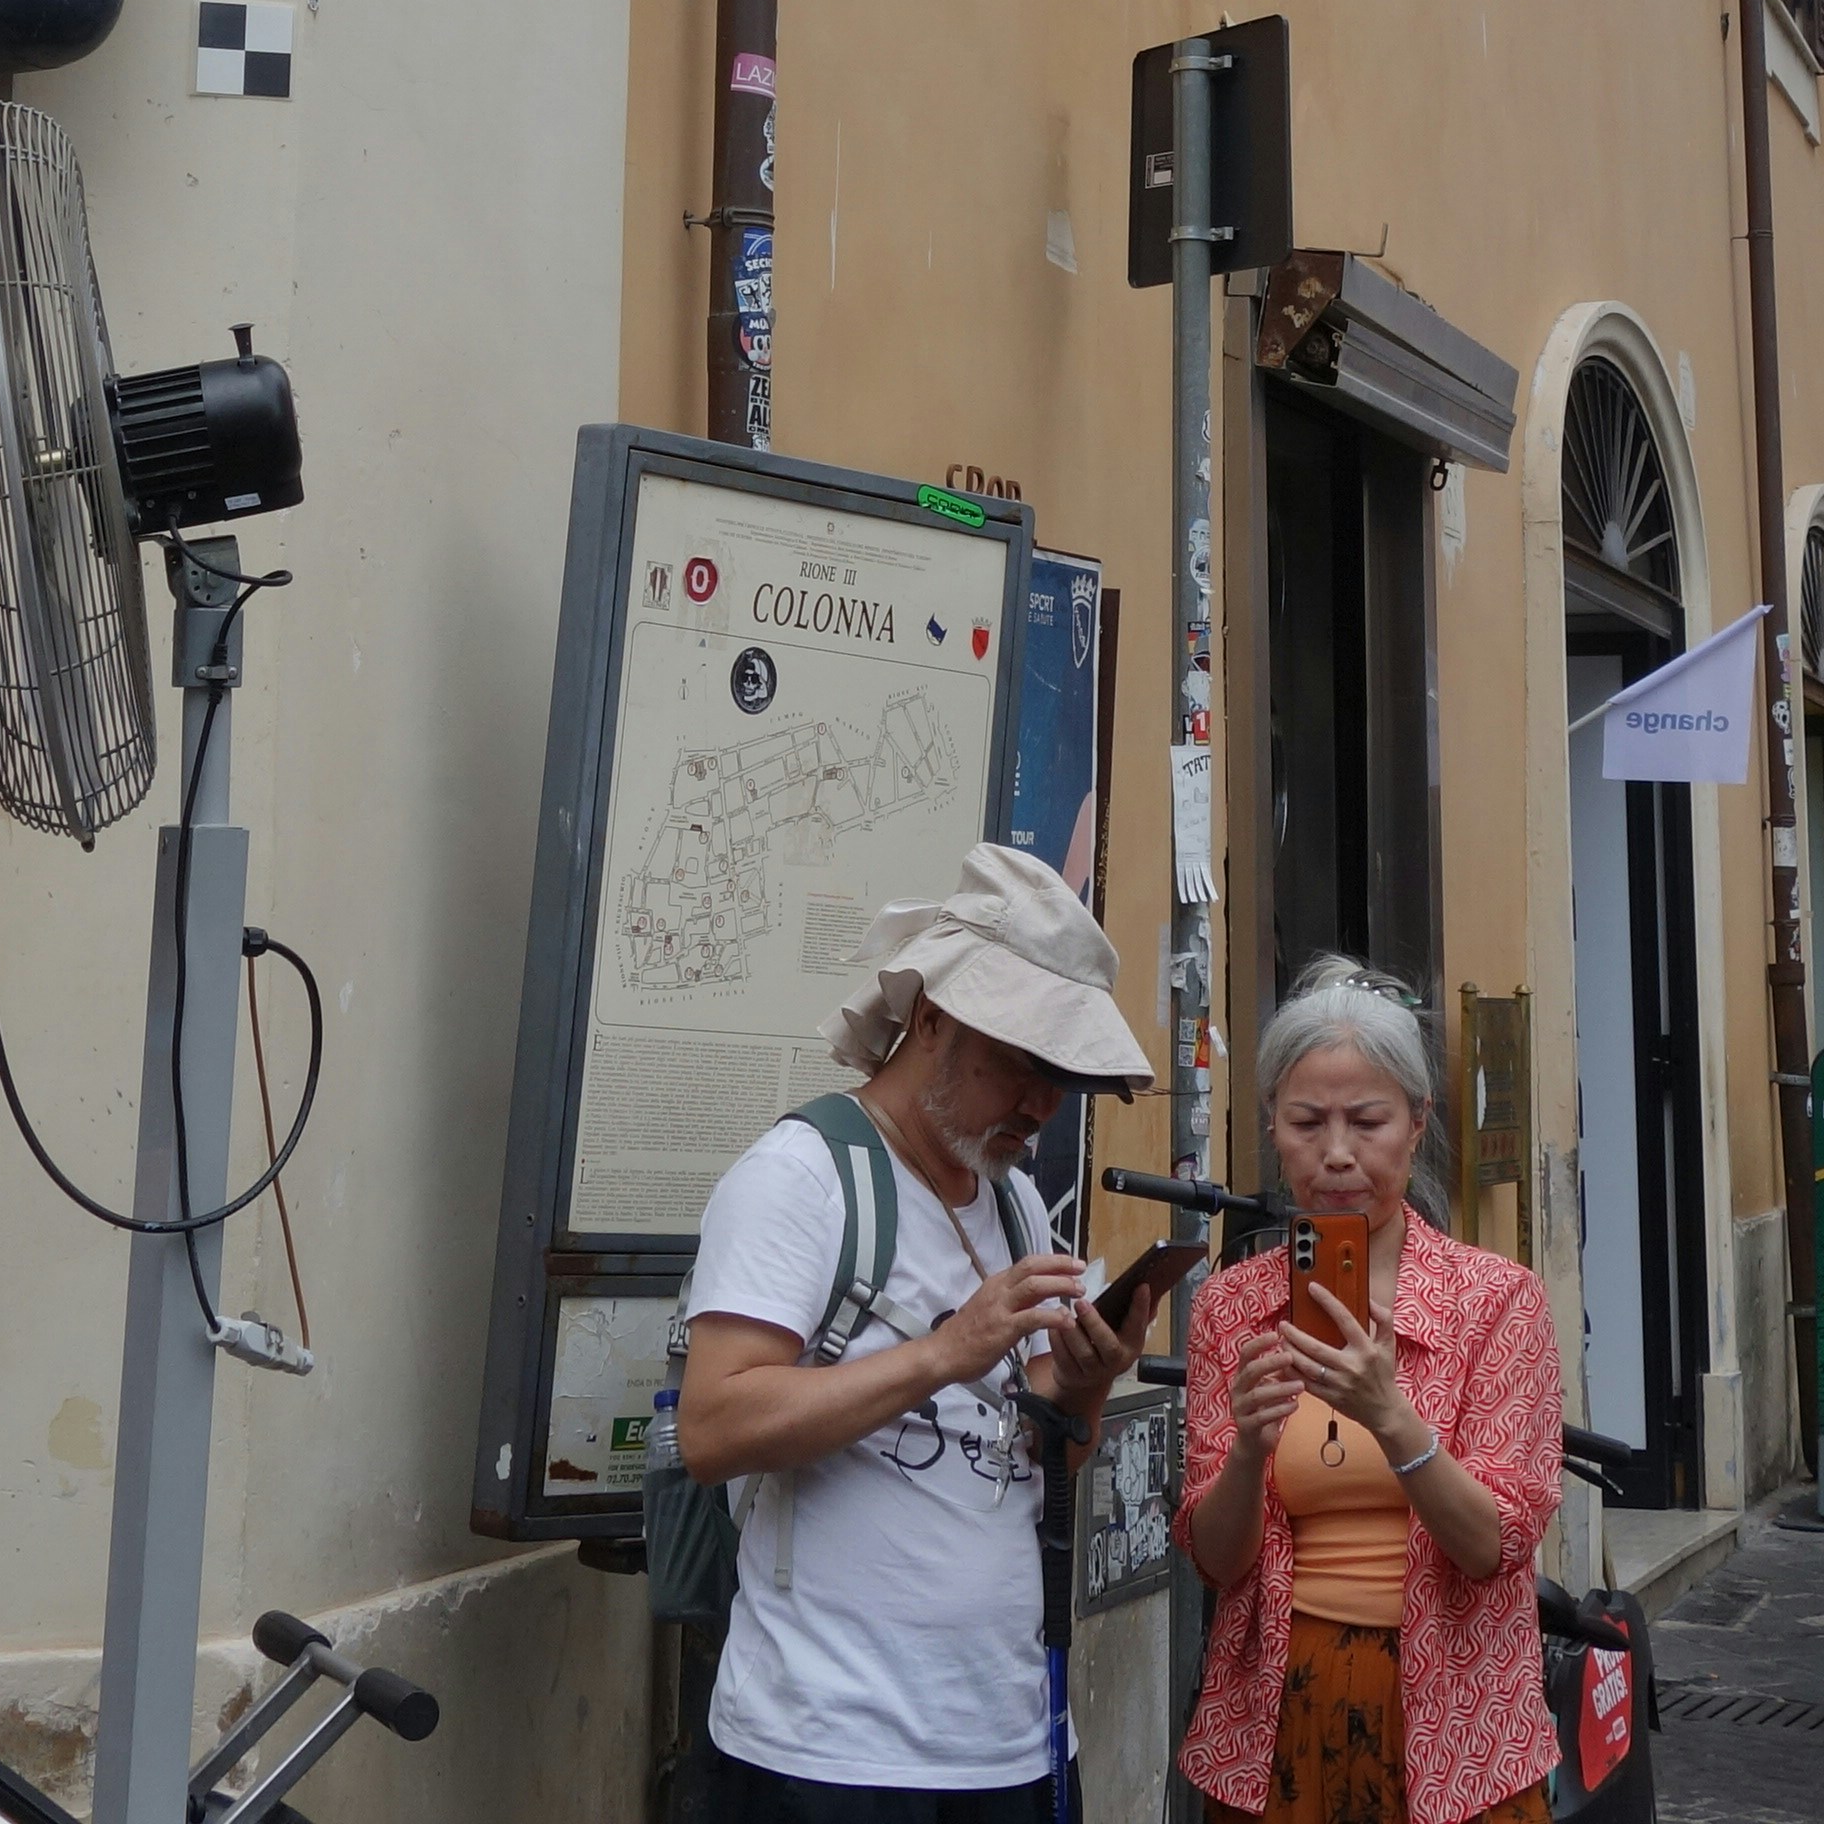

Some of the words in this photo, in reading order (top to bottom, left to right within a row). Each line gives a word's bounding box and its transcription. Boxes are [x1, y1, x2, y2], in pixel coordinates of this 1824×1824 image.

[798, 560, 837, 582] RIONE
[842, 567, 858, 587] III
[752, 583, 896, 645] COLONNA
[1028, 591, 1055, 613] SPORT
[1010, 830, 1036, 846] TOUR
[626, 1420, 647, 1442] Eu
[1591, 1663, 1629, 1721] GRATIS!
